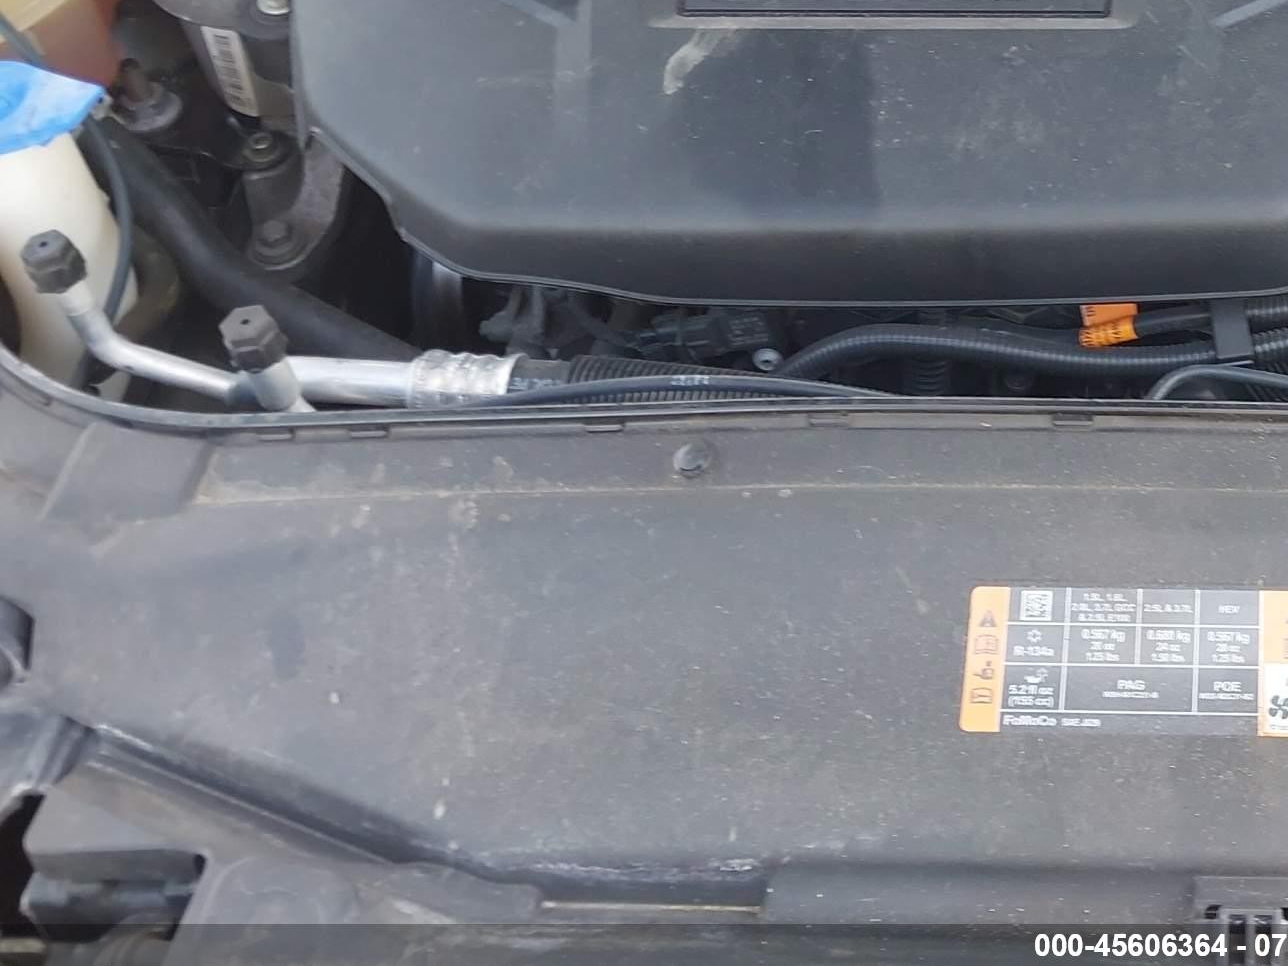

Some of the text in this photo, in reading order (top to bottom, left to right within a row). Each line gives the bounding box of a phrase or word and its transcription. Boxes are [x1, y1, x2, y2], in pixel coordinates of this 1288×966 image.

[1013, 645, 1055, 657] R-134a
[1008, 684, 1027, 694] 5.2
[1117, 679, 1146, 691] PAG
[1213, 681, 1242, 692] POE
[1002, 715, 1057, 727] FoMoCo
